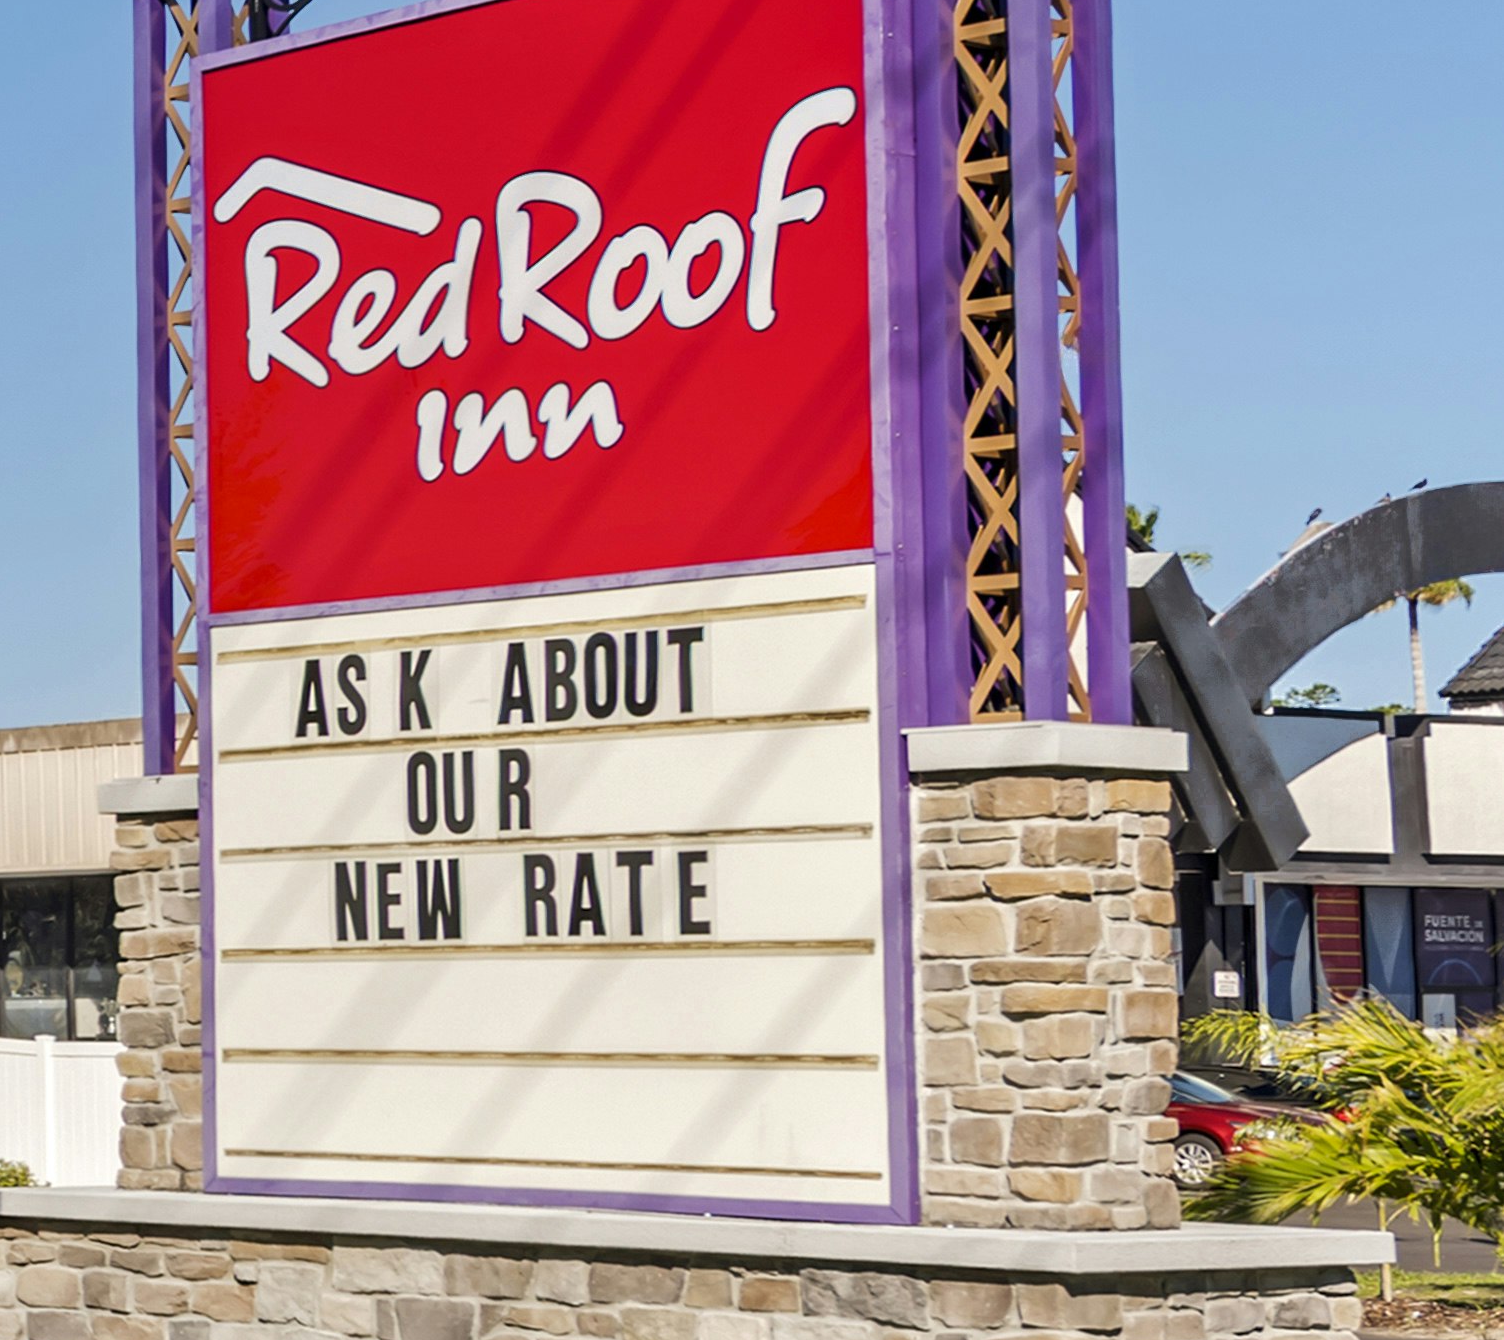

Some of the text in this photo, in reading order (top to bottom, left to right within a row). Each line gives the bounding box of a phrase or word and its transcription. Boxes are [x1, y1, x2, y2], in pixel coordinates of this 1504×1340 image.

[243, 86, 857, 388] Red Roof
[295, 625, 705, 738] ASK ABOUT
[407, 747, 532, 836] OUR
[334, 849, 712, 943] NEW RATE
[1425, 915, 1470, 928] FUENTE
